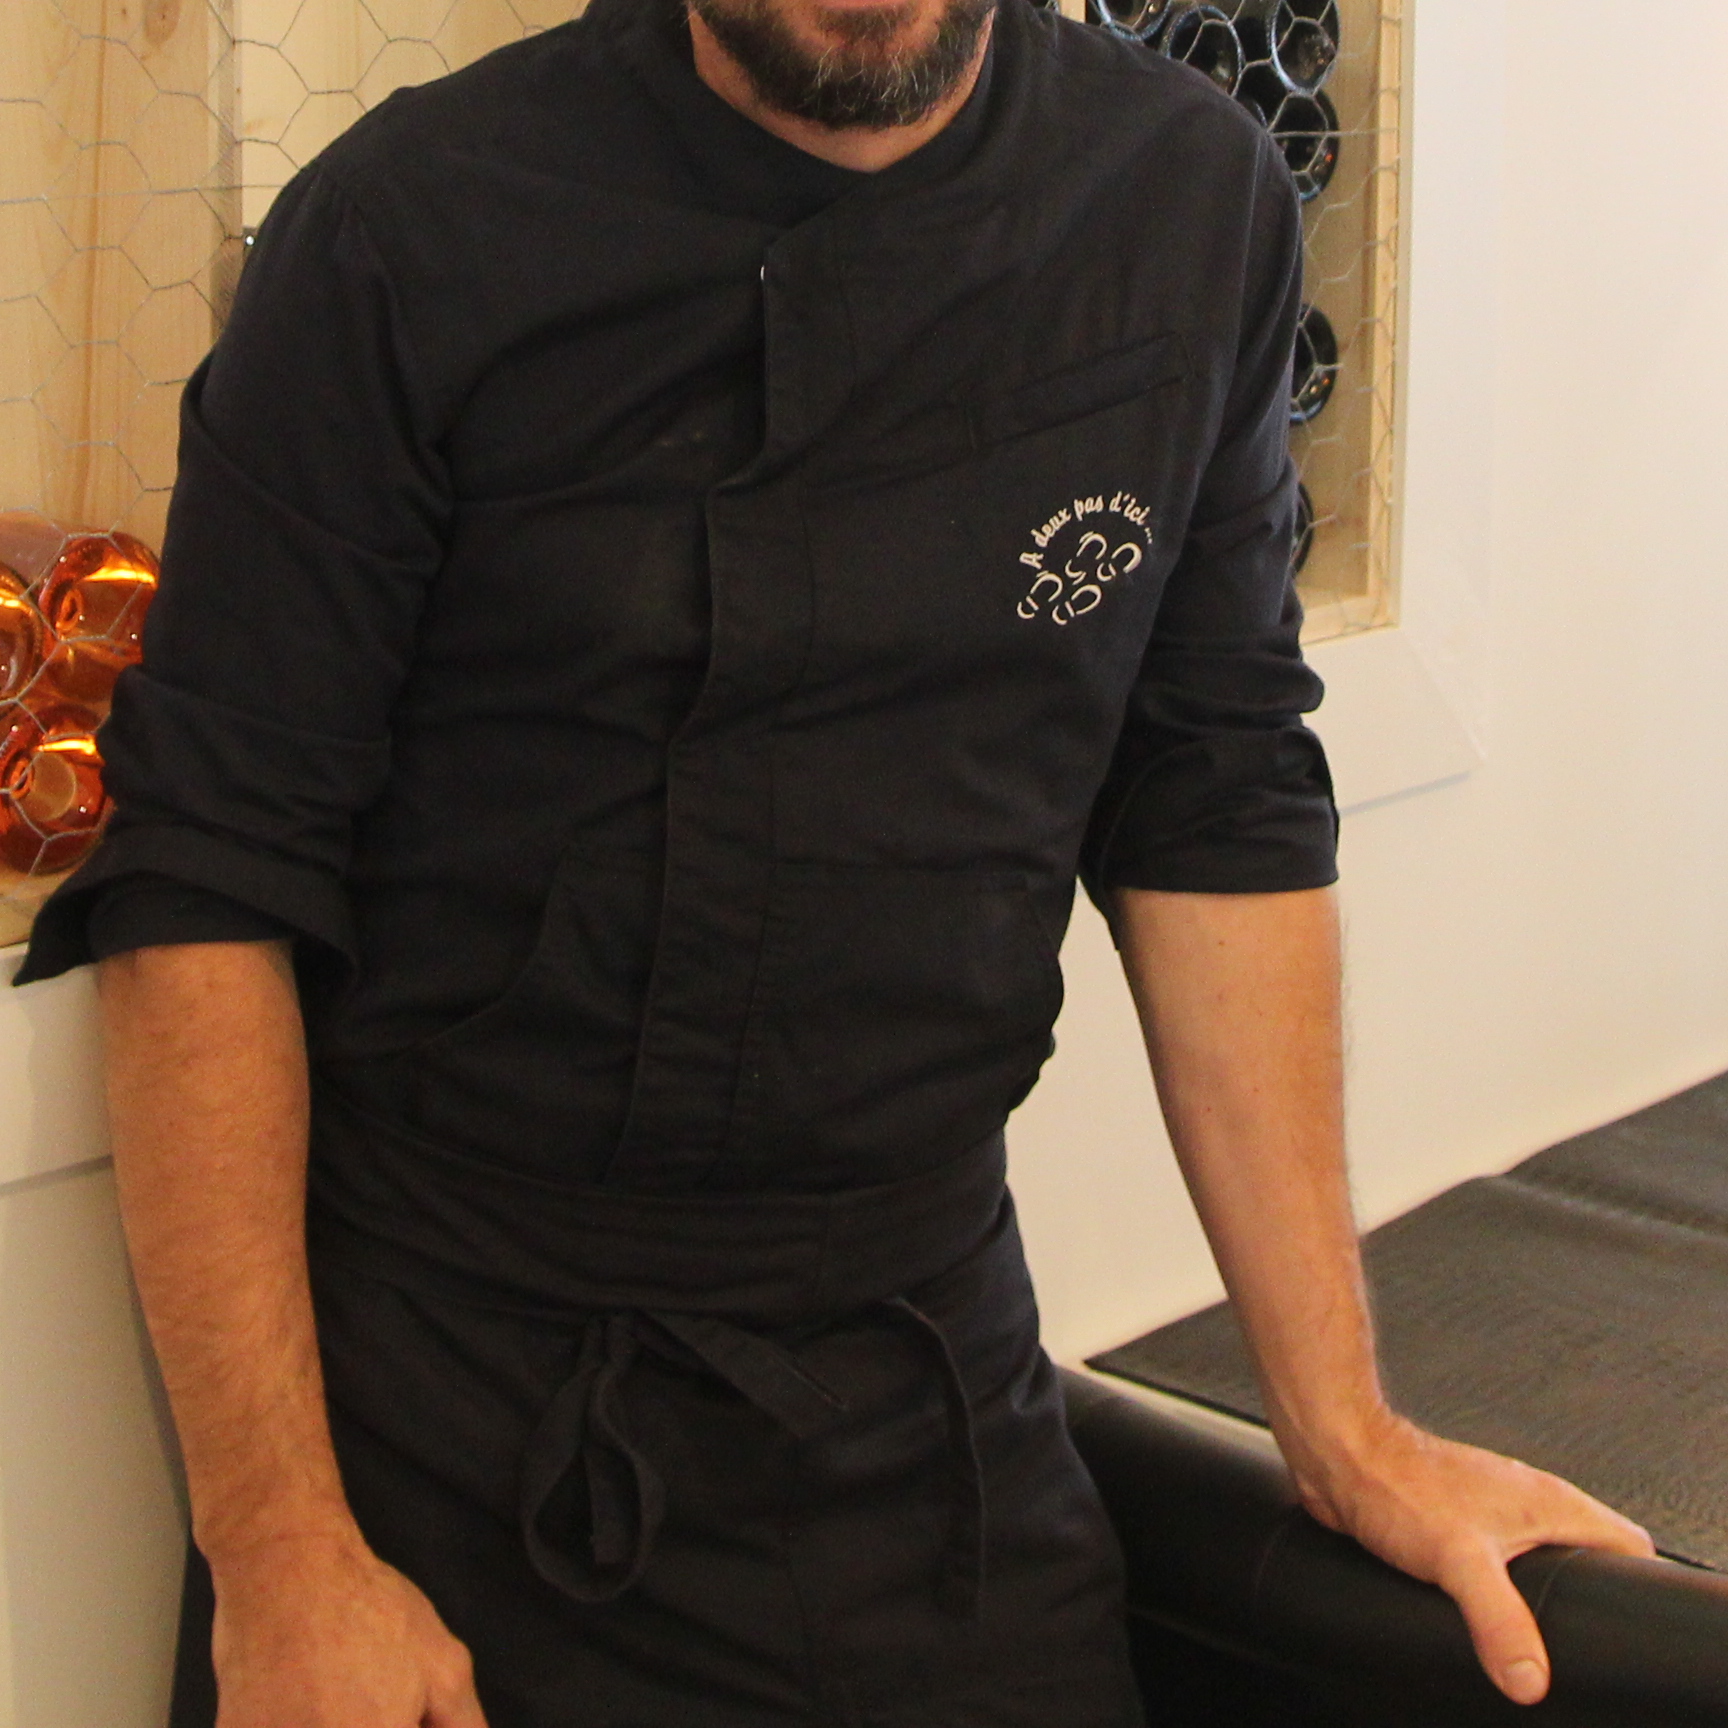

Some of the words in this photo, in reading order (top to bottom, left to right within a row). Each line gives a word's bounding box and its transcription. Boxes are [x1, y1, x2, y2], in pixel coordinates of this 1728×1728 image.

[1074, 495, 1104, 521] pas
[1031, 507, 1072, 548] deux
[1019, 551, 1044, 570] A
